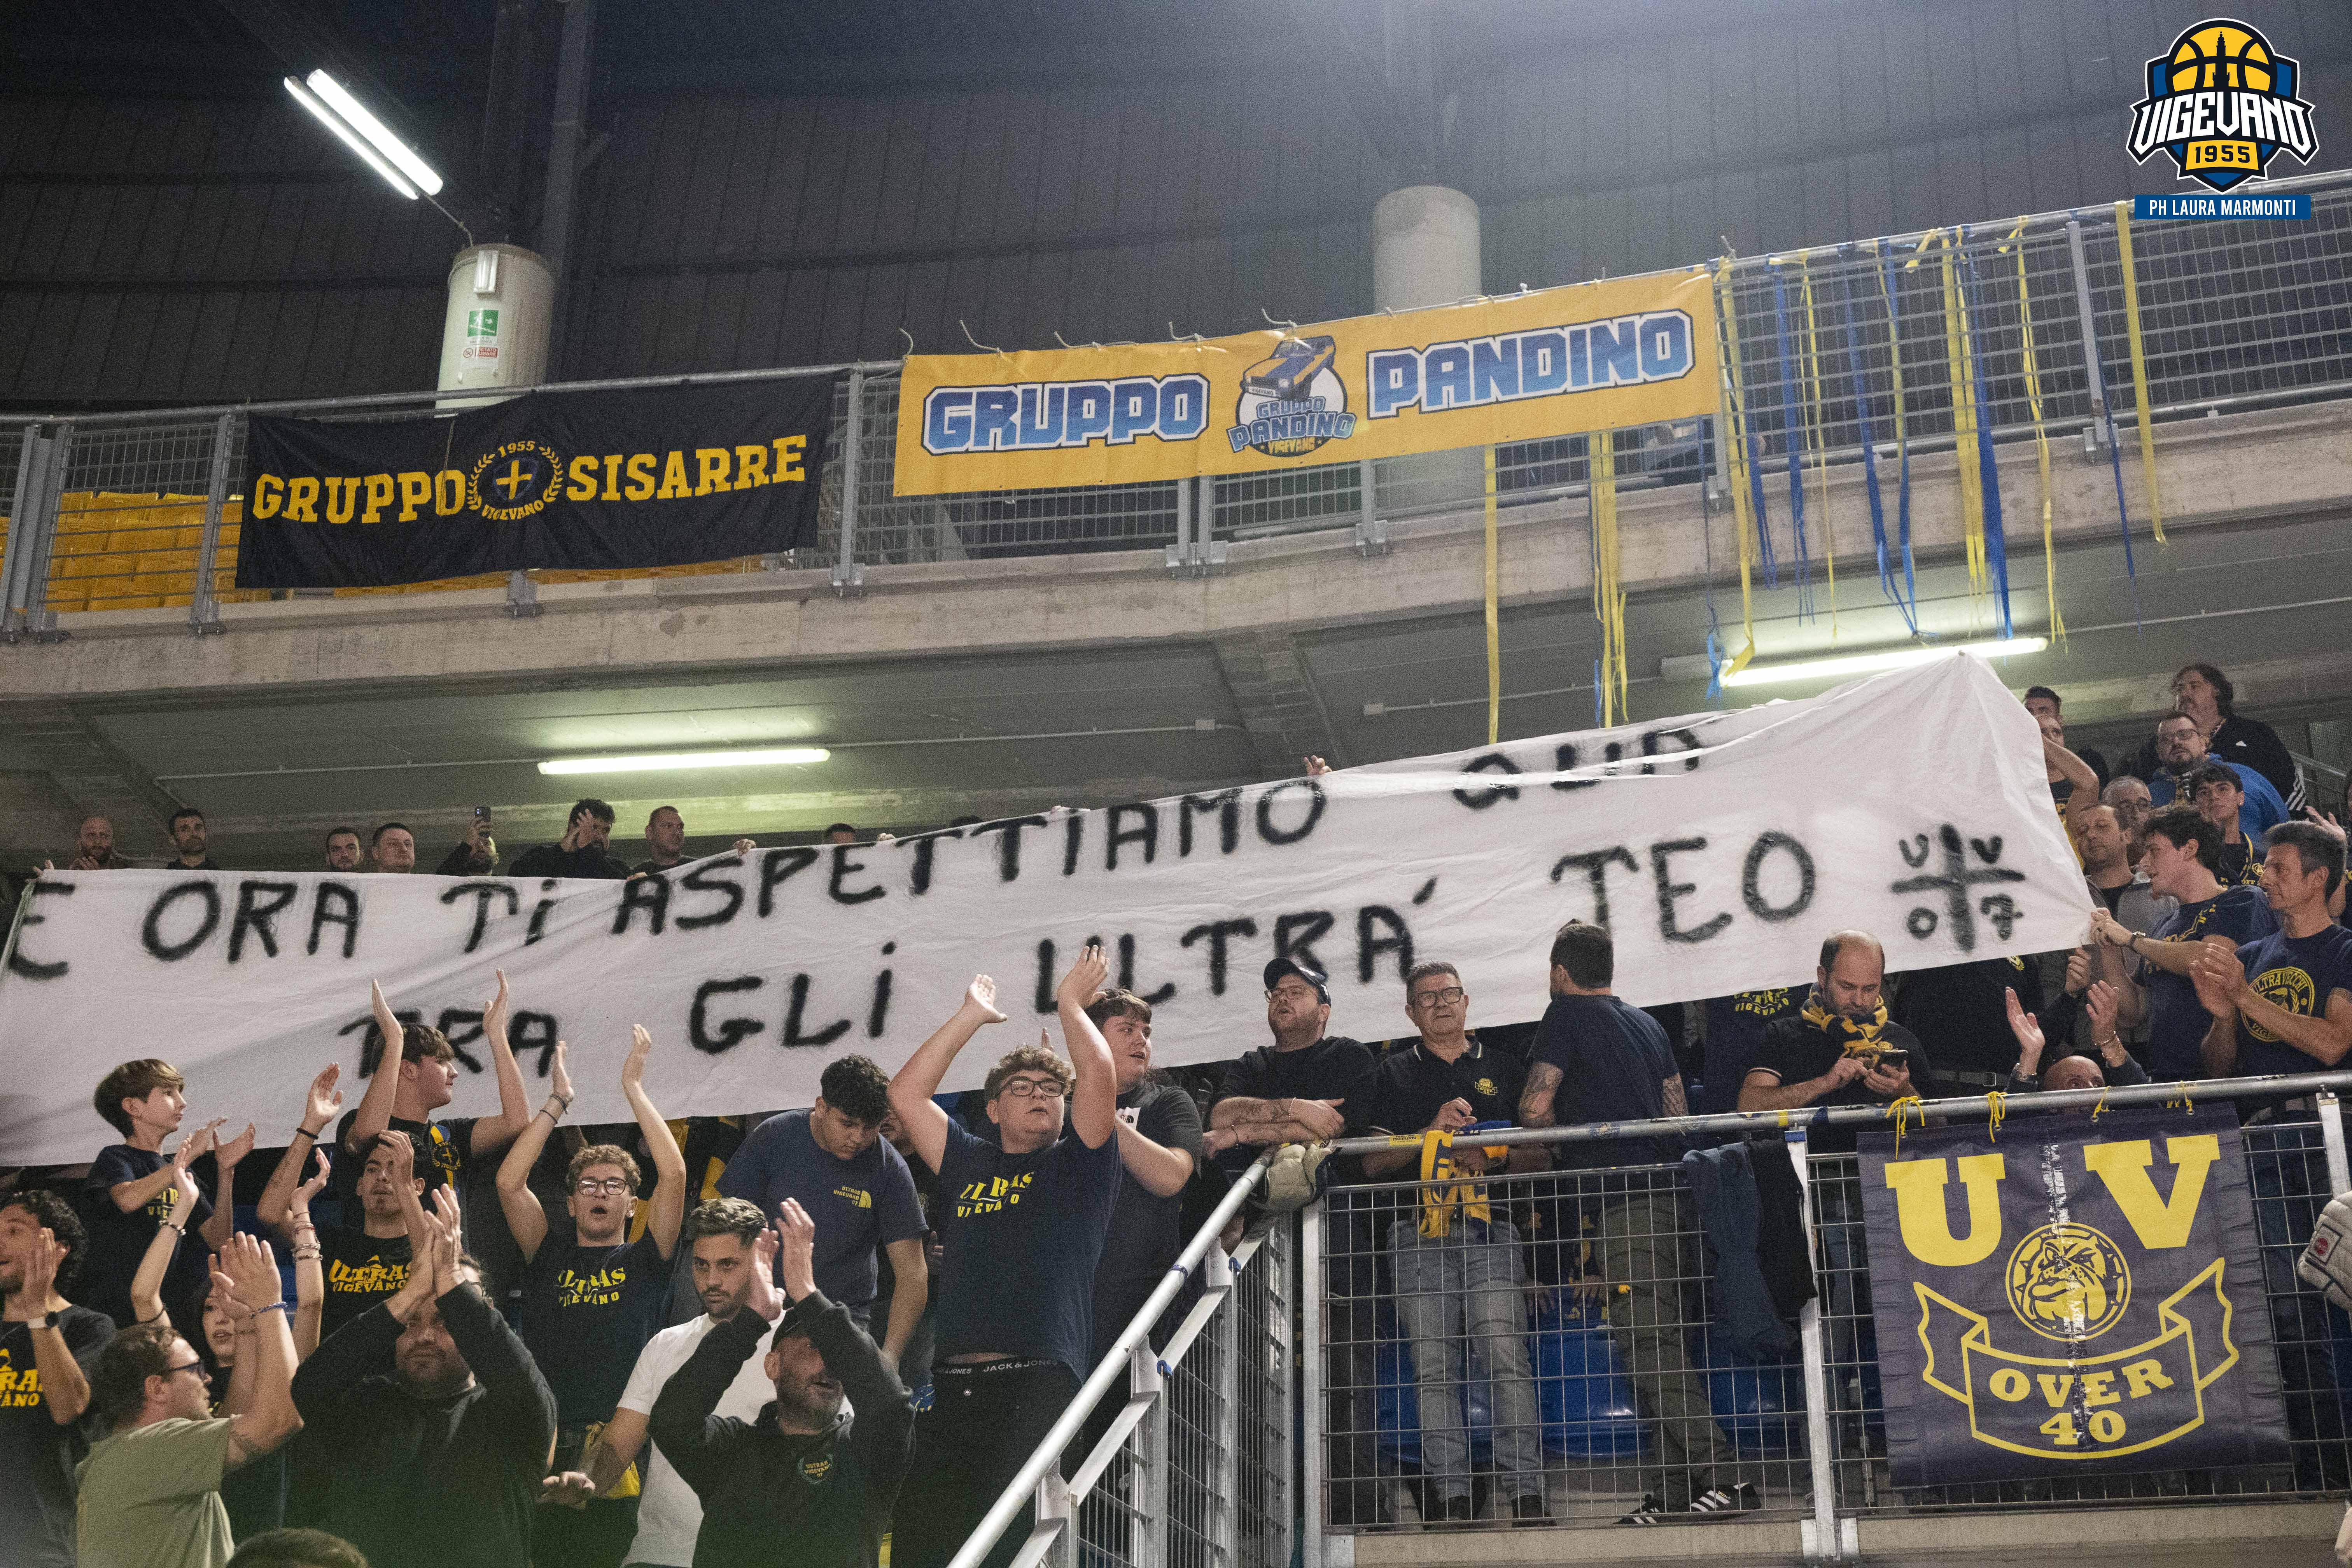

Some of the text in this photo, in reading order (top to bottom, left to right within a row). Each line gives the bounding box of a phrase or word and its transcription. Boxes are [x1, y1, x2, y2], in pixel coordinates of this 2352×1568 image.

[1365, 308, 1694, 419] PANDINO
[922, 373, 1211, 455] GRUPPO
[1226, 412, 1356, 453] PANDINO
[1256, 396, 1326, 419] GRUPPO
[498, 440, 536, 457] 1955
[565, 434, 807, 502] SISARRE
[253, 469, 466, 524] GRUPPO
[8, 881, 76, 977] E
[141, 880, 364, 964] ORA
[611, 779, 1328, 935] ASPETTIAMO
[1550, 830, 1816, 944] TEO
[1885, 1133, 2220, 1266] U V
[1990, 1357, 2174, 1408] OVER
[2039, 1409, 2127, 1446] 40
